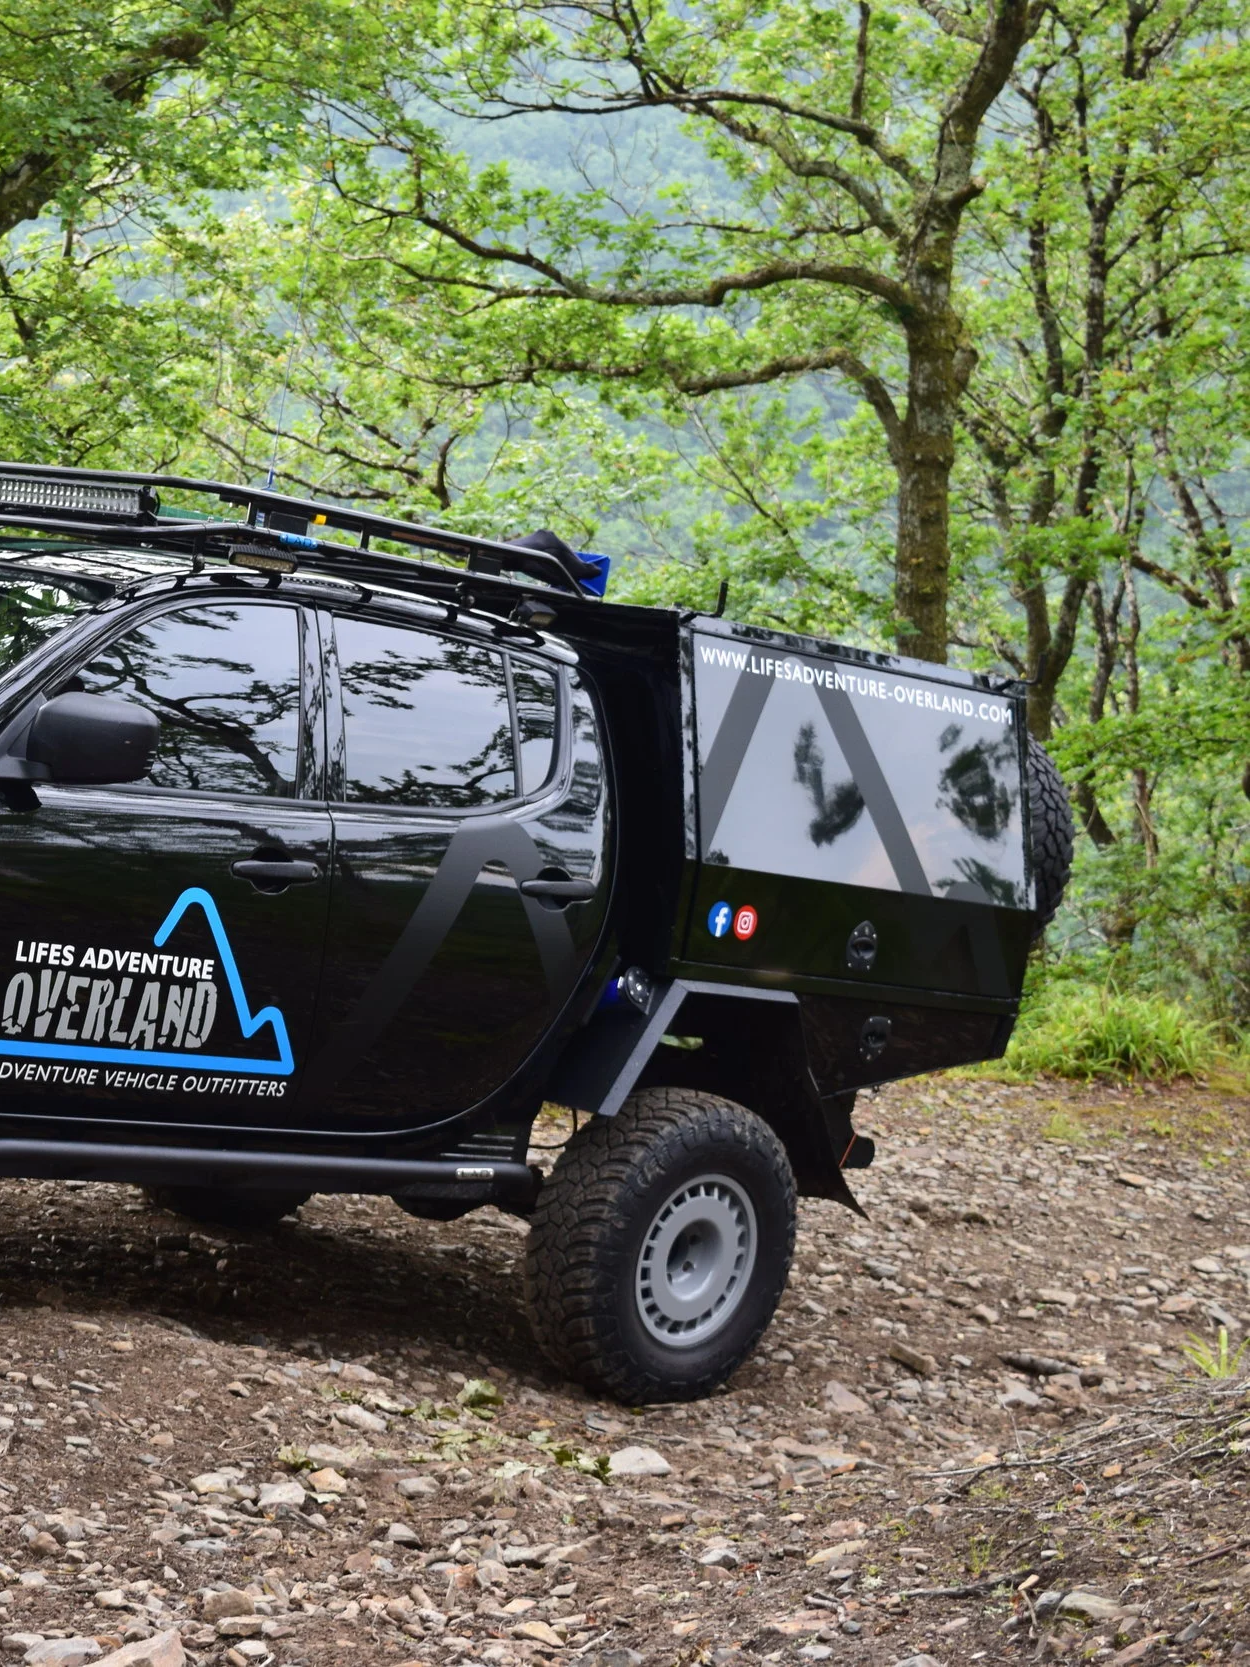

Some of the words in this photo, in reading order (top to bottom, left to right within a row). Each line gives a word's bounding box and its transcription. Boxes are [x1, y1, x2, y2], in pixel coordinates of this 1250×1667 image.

[699, 645, 1013, 726] WWW.LIFESADVENTURE-OVERLAND.COM
[15, 940, 75, 967] LIFES
[79, 947, 215, 980] ADVENTURE
[1, 969, 218, 1050] OVERLAND
[104, 1069, 178, 1091] VEHICLE
[182, 1076, 287, 1097] OUTFITTERS
